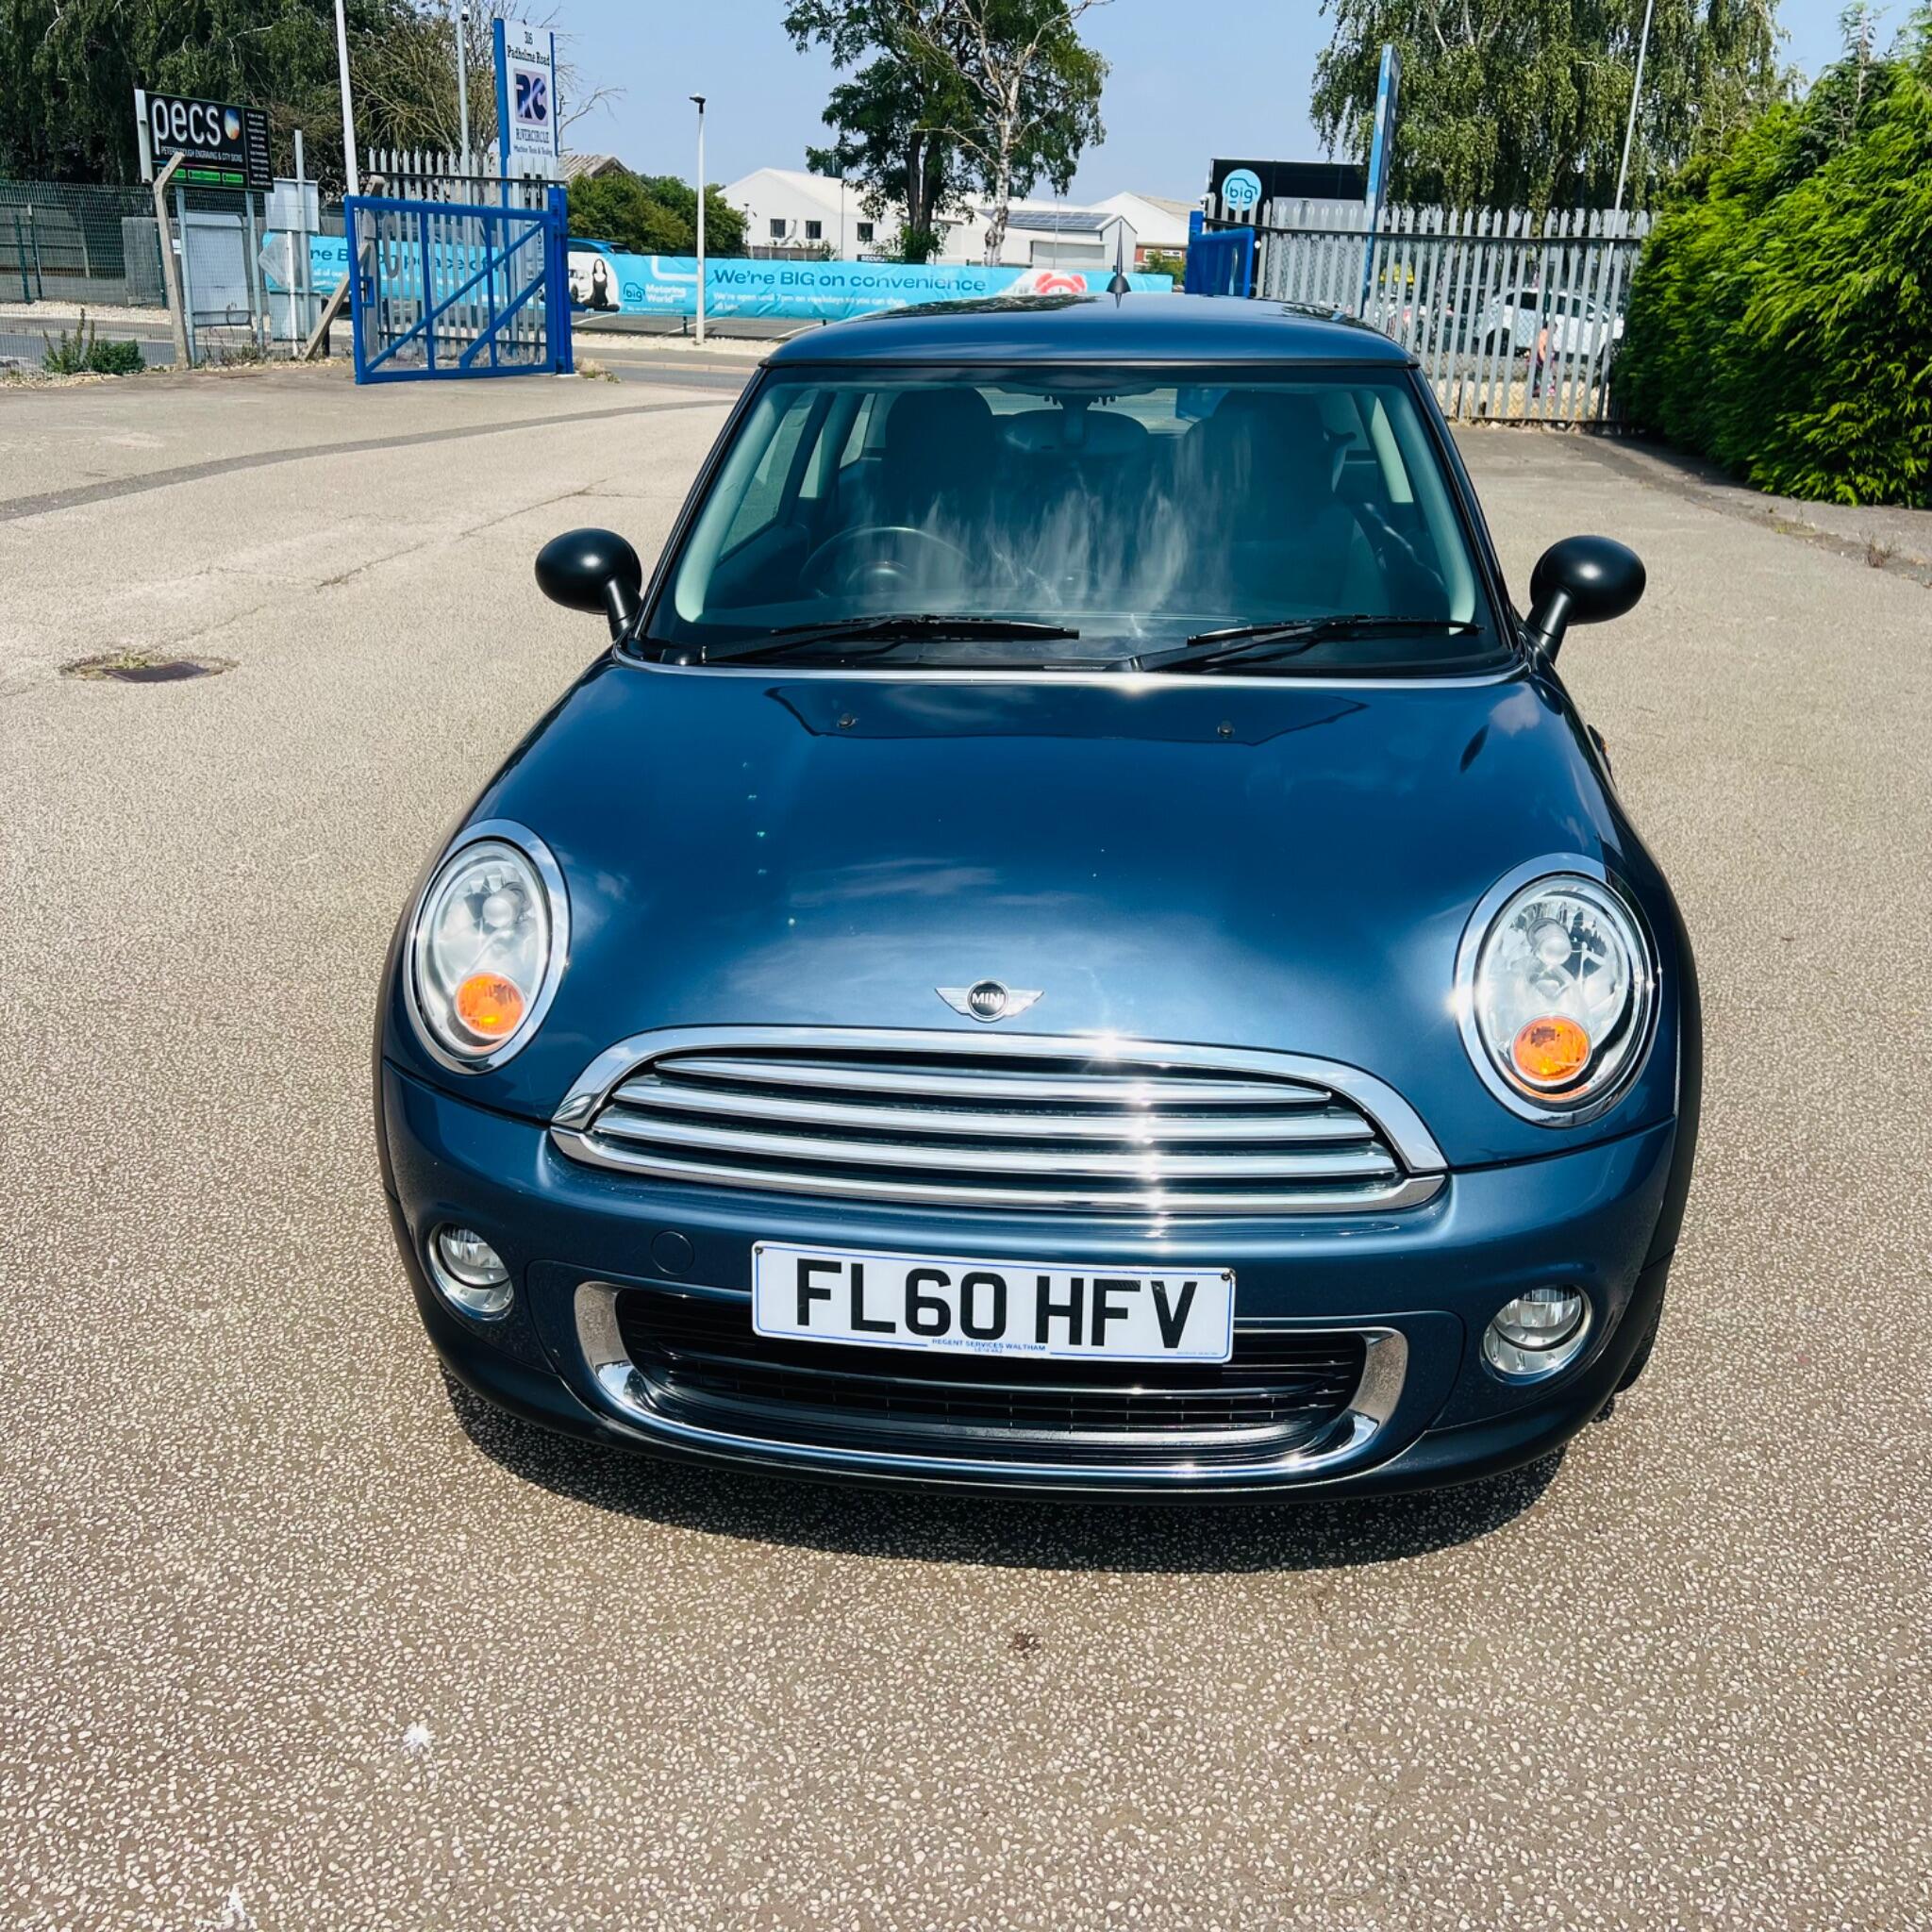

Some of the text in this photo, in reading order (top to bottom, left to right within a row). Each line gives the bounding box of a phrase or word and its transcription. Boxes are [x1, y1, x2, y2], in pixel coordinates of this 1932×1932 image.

[507, 44, 550, 66] Padholme Road
[152, 98, 222, 156] pecs
[1229, 186, 1254, 204] big
[713, 270, 986, 291] We're BIG on convenience
[972, 991, 1005, 1005] MINI
[796, 1257, 1198, 1349] FL60 HFV
[931, 1338, 1046, 1352] REGENT SERVICES WALTHAM
